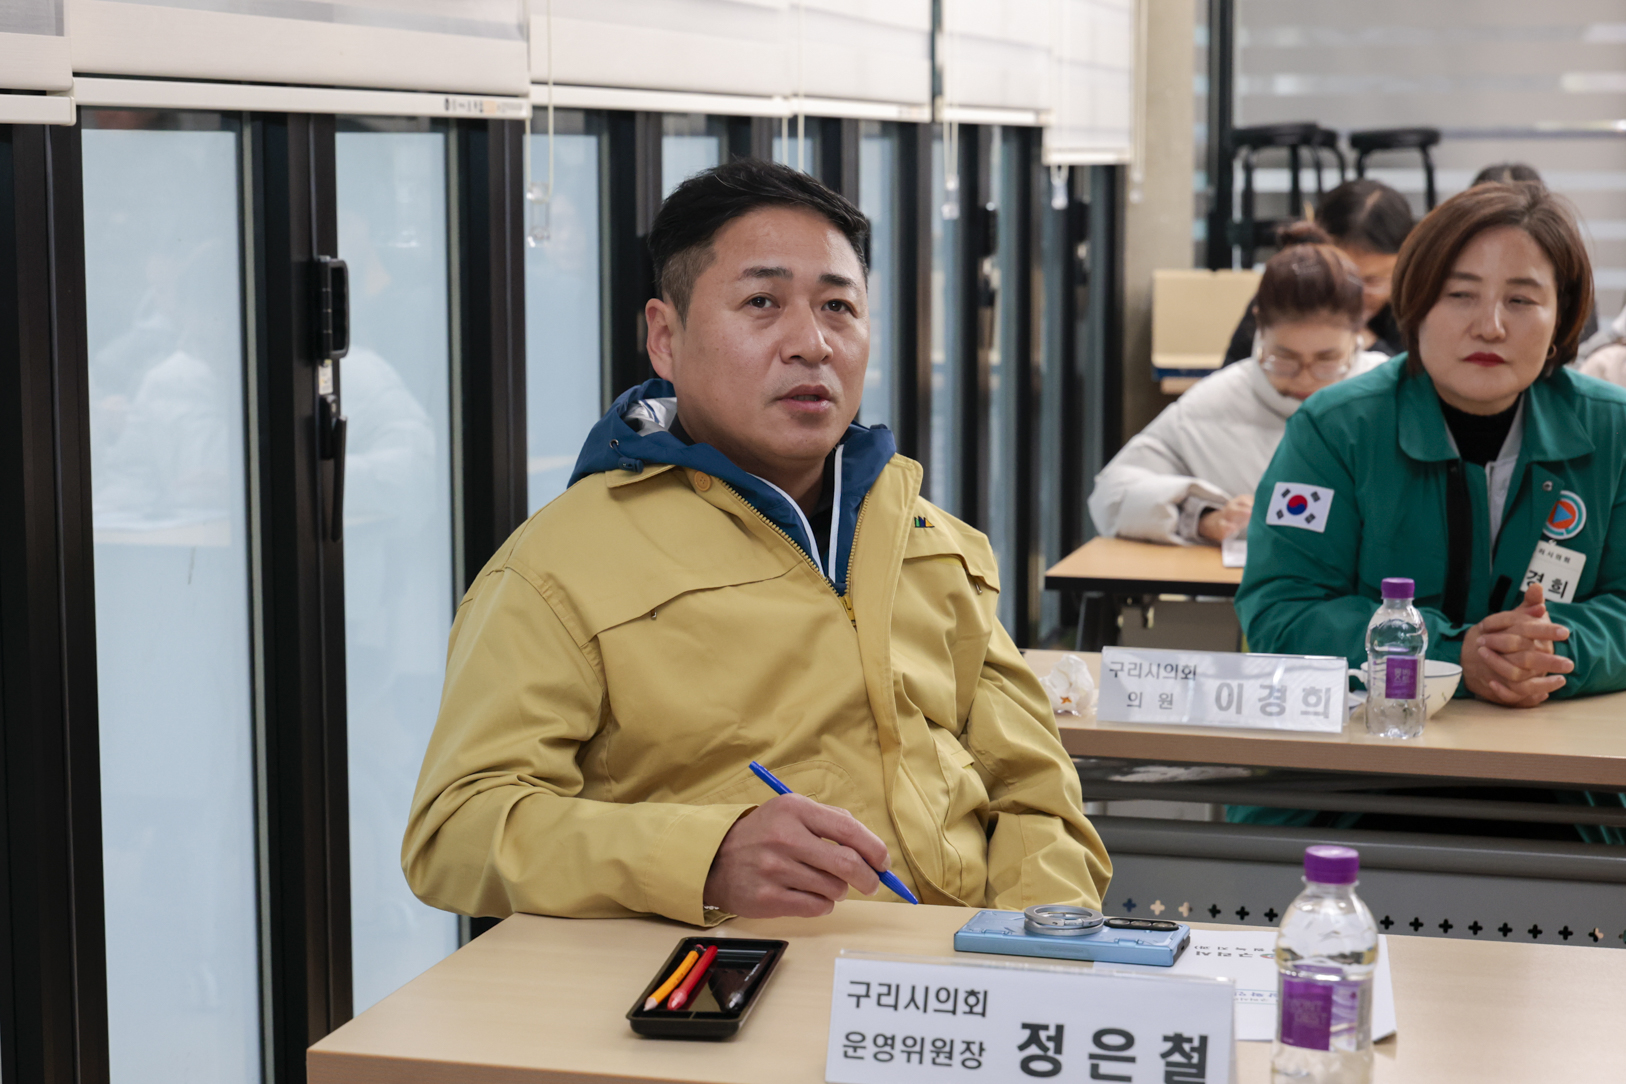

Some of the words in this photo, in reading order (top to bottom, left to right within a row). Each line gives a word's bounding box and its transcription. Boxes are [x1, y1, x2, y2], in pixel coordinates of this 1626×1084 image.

[1109, 661, 1197, 681] 구리시의회
[847, 980, 989, 1018] 구리시의회
[842, 1030, 986, 1070] 운영위원장
